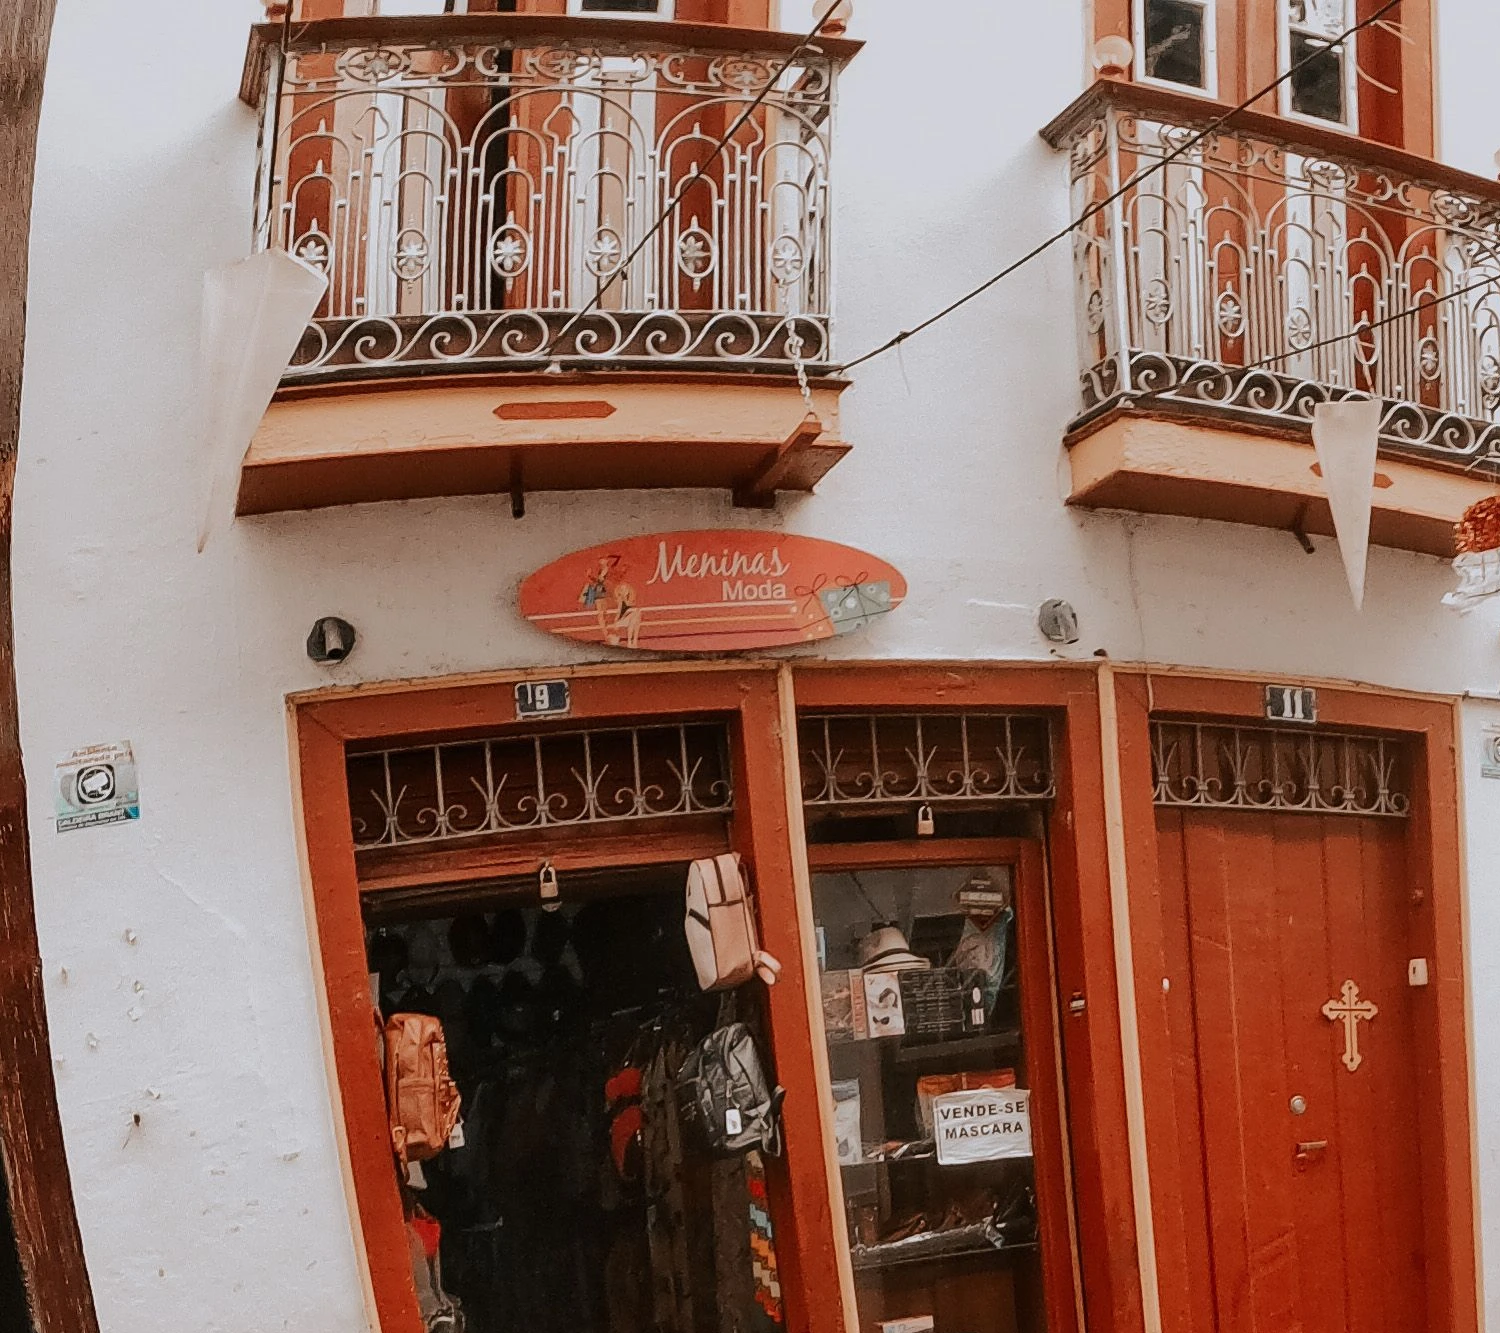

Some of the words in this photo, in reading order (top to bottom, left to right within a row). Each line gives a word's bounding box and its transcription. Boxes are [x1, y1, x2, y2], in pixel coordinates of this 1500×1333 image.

[646, 540, 790, 585] Meninas
[722, 582, 787, 602] Moda
[525, 682, 550, 710] 19
[1282, 688, 1304, 719] 11
[940, 1101, 1026, 1120] VENDE-SE
[945, 1121, 1024, 1140] MASCARA
